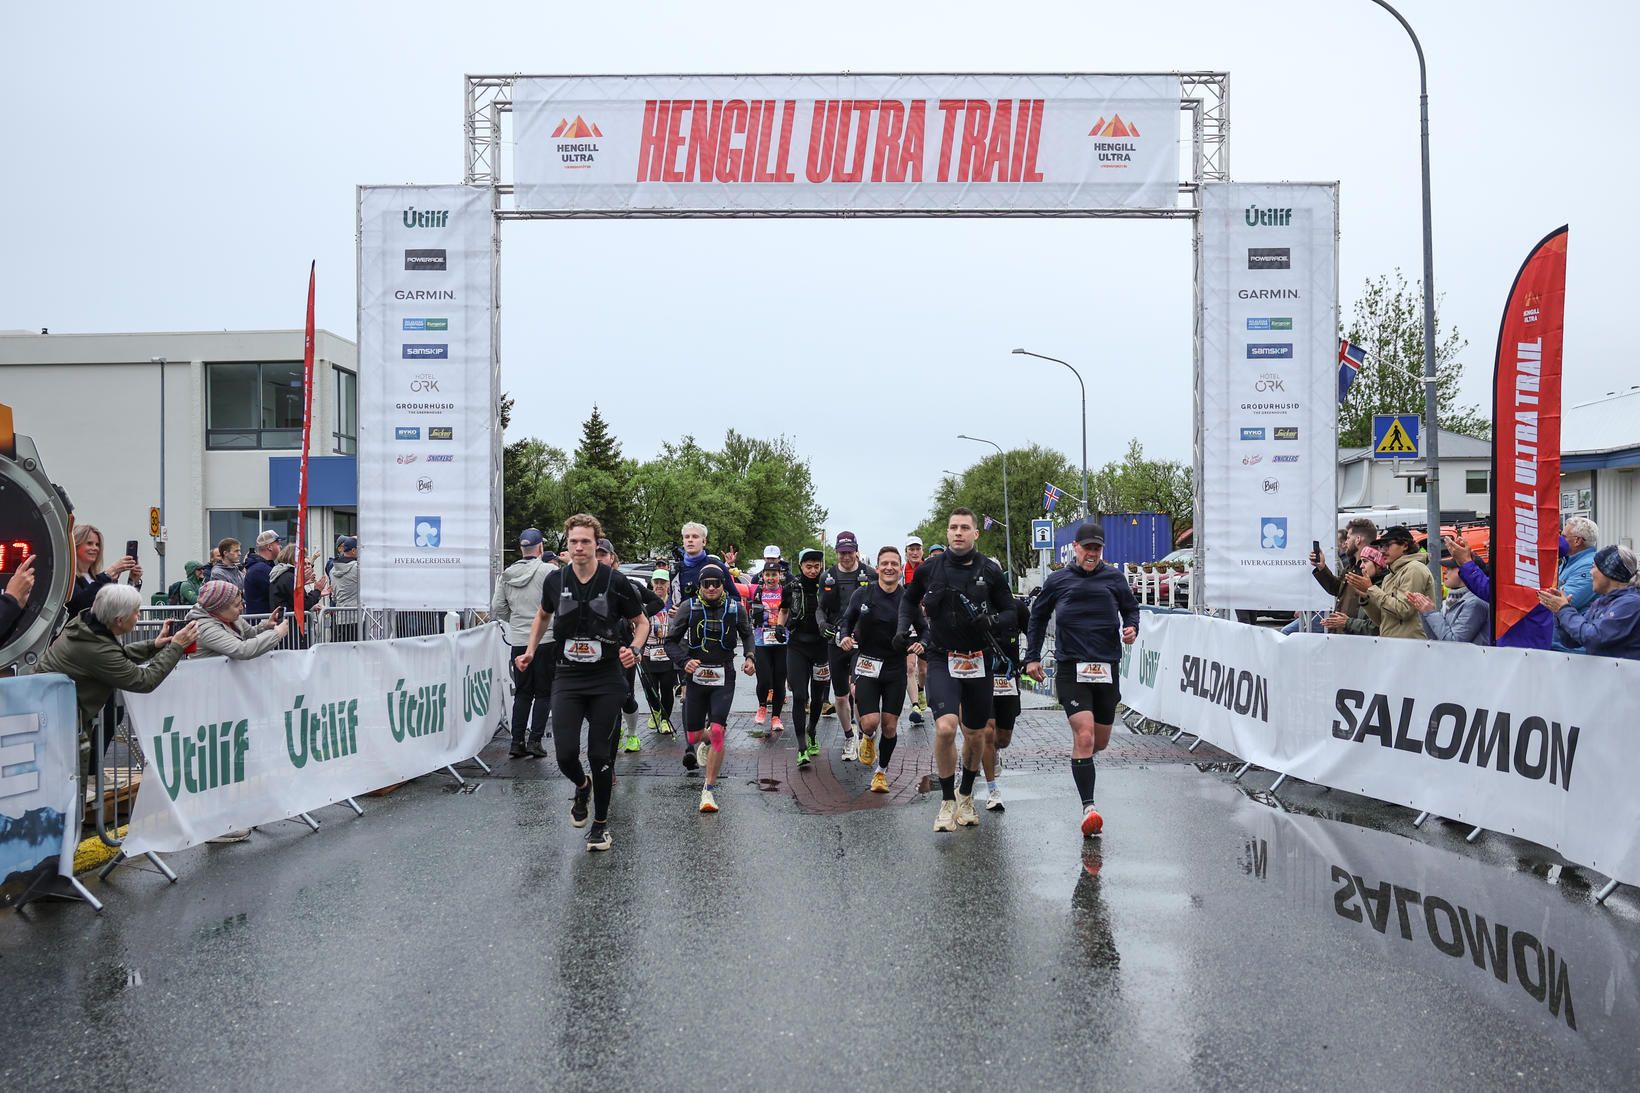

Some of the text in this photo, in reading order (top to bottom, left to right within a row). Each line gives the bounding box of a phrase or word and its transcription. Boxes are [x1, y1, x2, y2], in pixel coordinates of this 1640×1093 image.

[557, 144, 599, 152] HENGILL
[636, 99, 1045, 183] HENGILL ULTRA TRAIL
[1094, 143, 1136, 152] HENGILL
[561, 153, 594, 162] ULTRA
[1098, 153, 1131, 162] ULTRA
[403, 206, 449, 228] Útilíf
[1245, 204, 1292, 227] Útilíf
[394, 290, 454, 300] GARMIN
[1238, 290, 1298, 299] GARMIN
[1514, 336, 1542, 590] HENGILL ULTRA TRAIL
[576, 642, 589, 651] 123
[1088, 664, 1100, 673] 127
[1180, 654, 1268, 723] SALOMON
[386, 678, 447, 743] Útilíf
[284, 694, 358, 769] Útilíf
[1332, 688, 1580, 792] SALOMON
[153, 716, 249, 802] Útilíf
